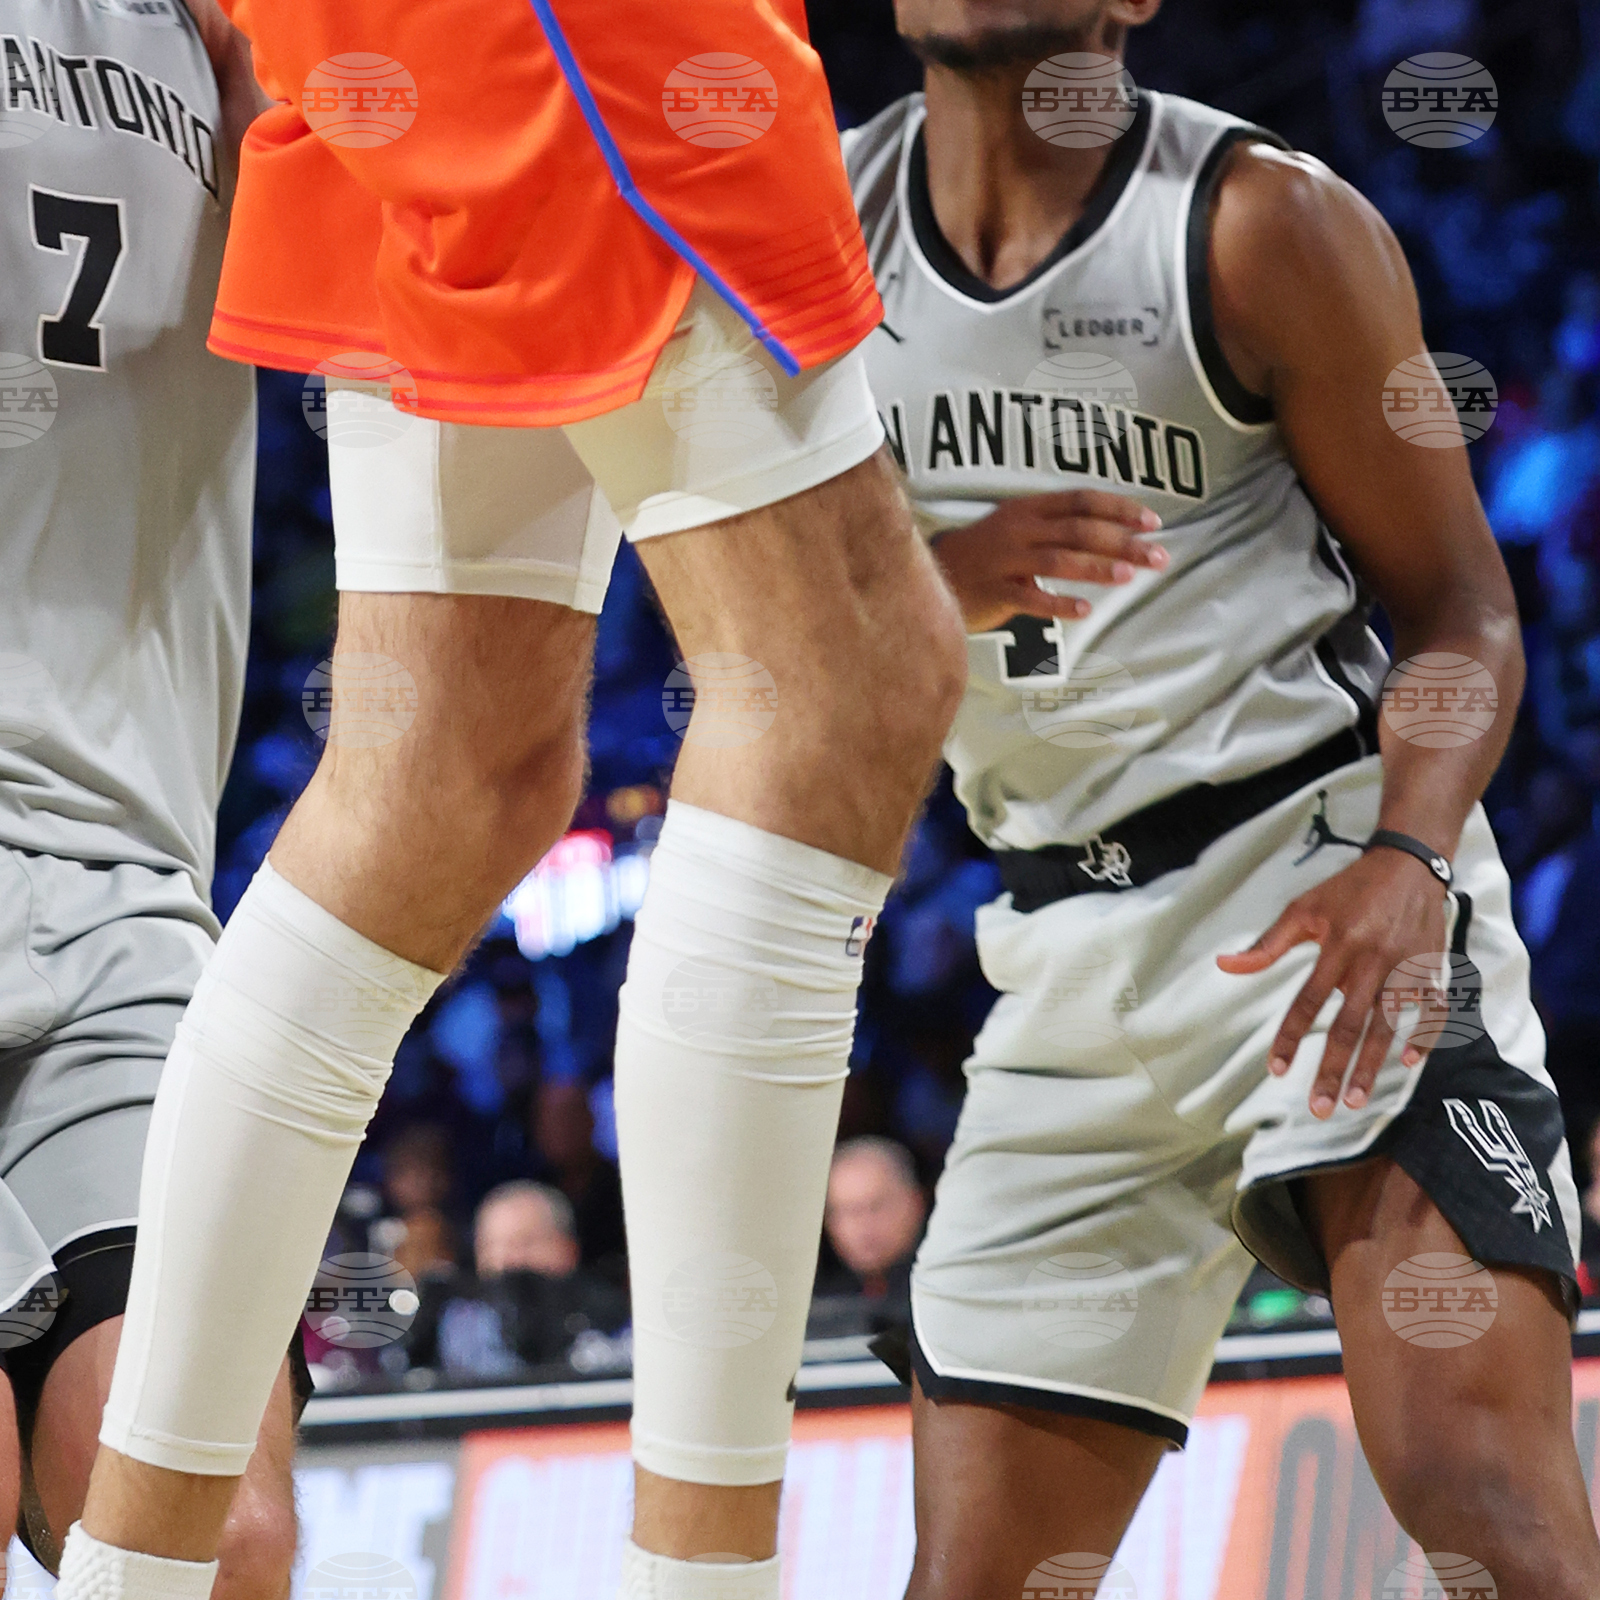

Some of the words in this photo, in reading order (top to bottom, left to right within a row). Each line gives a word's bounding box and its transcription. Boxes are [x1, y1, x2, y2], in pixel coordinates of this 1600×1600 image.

[0, 33, 220, 200] ANTONIO
[27, 184, 128, 373] 7
[1058, 317, 1145, 338] LEDGER
[926, 386, 1209, 502] ANTONIO
